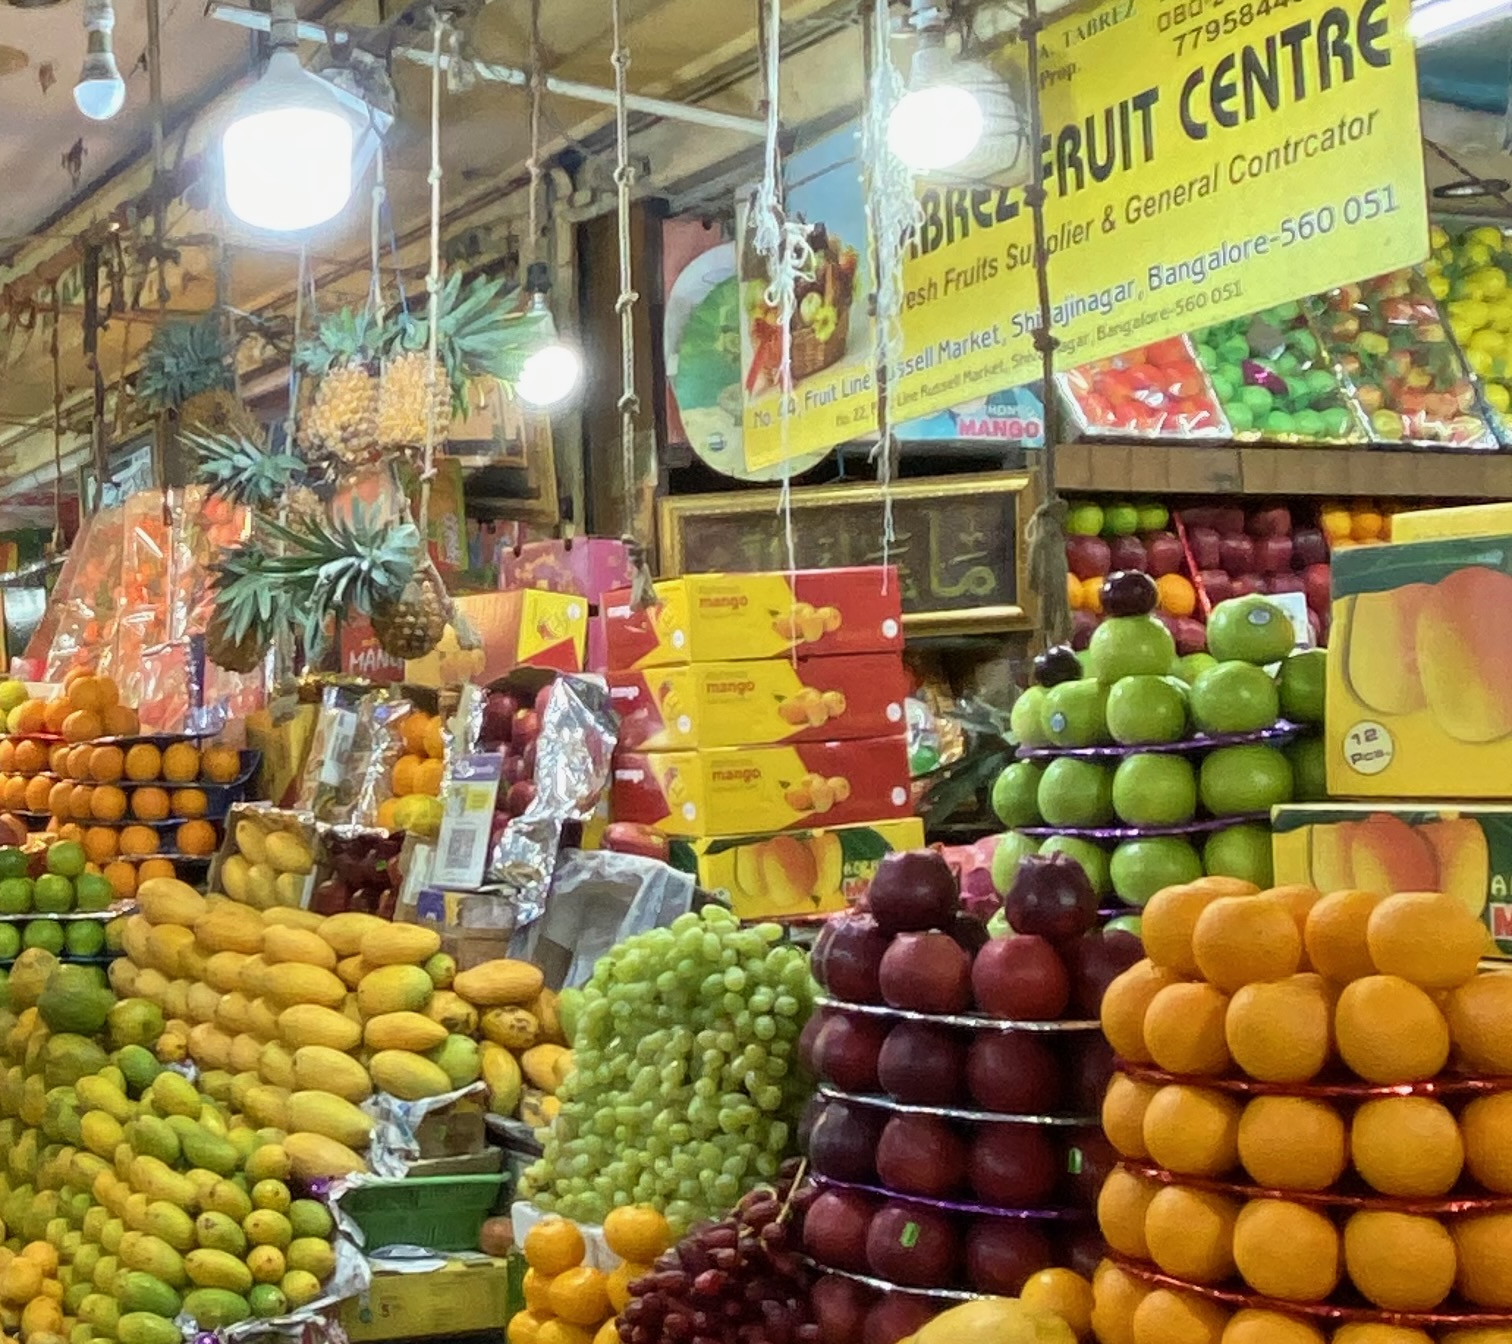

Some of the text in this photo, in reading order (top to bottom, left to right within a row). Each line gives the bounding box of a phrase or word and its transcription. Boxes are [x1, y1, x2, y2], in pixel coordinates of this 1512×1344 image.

[943, 257, 998, 296] Fruits
[1006, 218, 1096, 271] Suplier
[1101, 204, 1116, 235] &
[1125, 162, 1220, 224] General
[1229, 108, 1380, 185] Contrcator
[804, 383, 838, 411] Fruit
[841, 372, 872, 398] Line
[938, 325, 1007, 364] Market,
[1011, 278, 1146, 338] Shiajinagar,
[1148, 206, 1335, 292] Bangalore-560
[1343, 183, 1401, 226] 051
[958, 418, 1041, 439] MANGO
[699, 595, 749, 610] mango
[706, 680, 756, 696] mango
[1351, 727, 1379, 746] 12
[712, 767, 762, 784] mango
